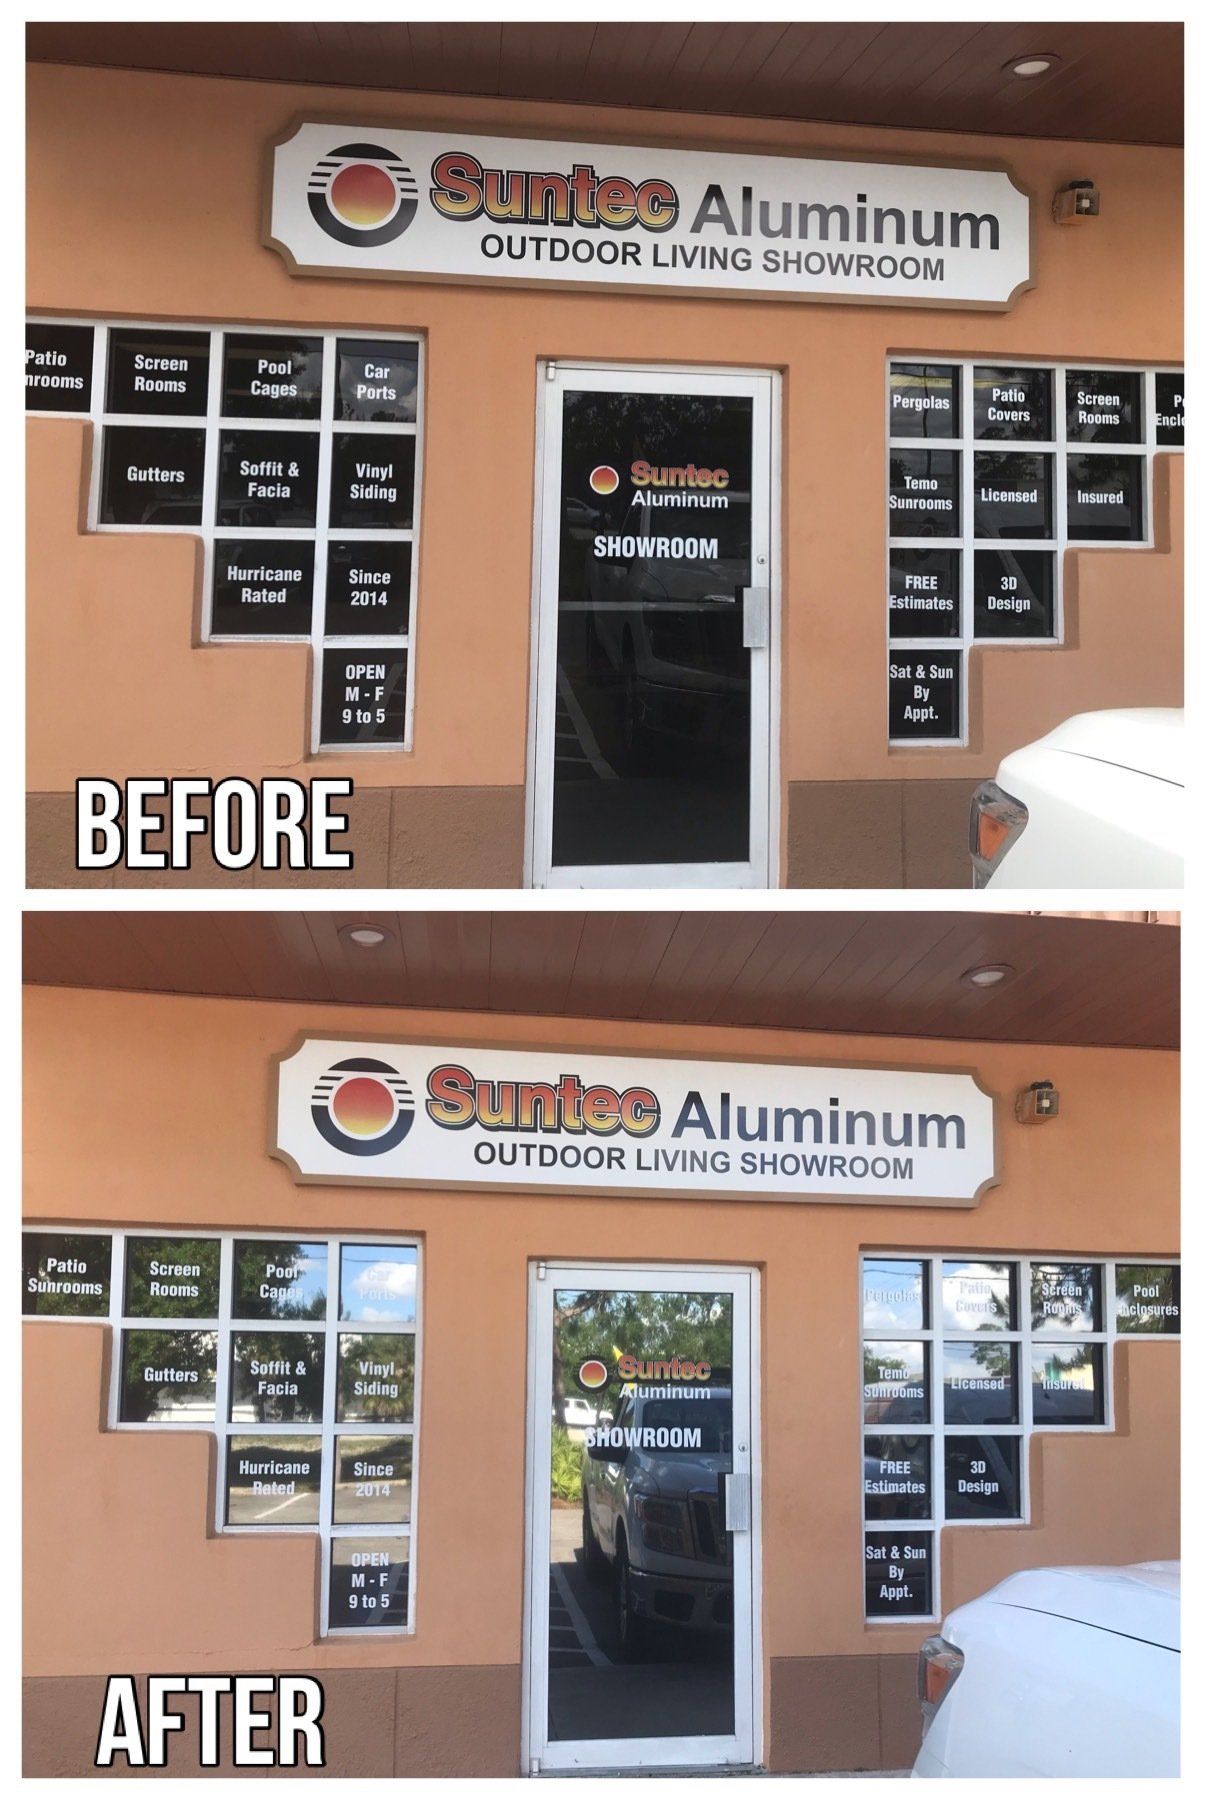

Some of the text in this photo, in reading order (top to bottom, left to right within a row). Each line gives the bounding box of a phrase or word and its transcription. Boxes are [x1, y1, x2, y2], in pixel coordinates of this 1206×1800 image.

[429, 151, 1000, 250] Suntec Aluminum
[480, 234, 944, 281] OUTDOOR LIVING SHOWROOM
[25, 349, 67, 366] Patio
[134, 354, 188, 372] Screen
[257, 359, 292, 375] Pool
[364, 364, 390, 379] Car
[134, 376, 187, 393] Rooms
[251, 381, 297, 398] Cages
[357, 384, 396, 400] Ports
[893, 394, 950, 411] Pergolas
[992, 388, 1025, 403] Patio
[1077, 392, 1120, 406] Screen
[988, 407, 1030, 422] Covers
[1079, 411, 1120, 425] Rooms
[127, 466, 185, 483] Gutters
[240, 460, 300, 478] Soffit &
[355, 463, 393, 481] Vinyl
[631, 460, 729, 488] Suntec
[248, 482, 291, 499] Facia
[904, 476, 938, 491] Temo
[350, 484, 397, 503] Siding
[632, 490, 728, 508] Aluminum
[981, 488, 1037, 503] Licensed
[1077, 490, 1124, 505] Insured
[889, 496, 953, 511] Sunrooms
[594, 535, 718, 559] SHOWROOM
[227, 566, 302, 582] Hurricane
[349, 569, 391, 585] Since
[905, 575, 938, 590] FREE
[1000, 576, 1017, 590] 3D
[241, 587, 287, 603] Rated
[350, 591, 387, 606] 2014
[889, 595, 954, 611] Estimates
[987, 596, 1030, 613] Design
[345, 664, 386, 680] OPEN
[889, 665, 953, 679] Sat & Sun
[345, 687, 359, 702] M
[375, 686, 385, 701] F
[913, 685, 930, 701] By
[342, 709, 386, 724] 9 to 5
[904, 705, 939, 722] Appt.
[425, 1064, 966, 1149] Suntec Aluminum
[474, 1142, 914, 1179] OUTDOOR LIVING SHOWROOM
[46, 1257, 87, 1274] Patio
[150, 1260, 200, 1278] Screen
[266, 1263, 298, 1279] Pool
[27, 1278, 103, 1295] Sunrooms
[150, 1281, 199, 1298] Rooms
[260, 1284, 303, 1302] Cages
[960, 1281, 991, 1294] Patio
[1042, 1283, 1082, 1296] Screen
[1133, 1284, 1159, 1297] Pool
[955, 1300, 997, 1313] Covers
[1043, 1301, 1082, 1314] Rooms
[1116, 1303, 1179, 1316] nclosures
[144, 1367, 199, 1383] Gutters
[250, 1360, 307, 1376] Soffit &
[359, 1361, 394, 1378] Vinyl
[618, 1355, 712, 1381] Suntec
[878, 1366, 910, 1380] Temo
[258, 1381, 299, 1396] Facia
[354, 1381, 399, 1399] Siding
[951, 1377, 1005, 1390] Licensed
[619, 1384, 711, 1400] Aluminum
[864, 1385, 924, 1399] Sunrooms
[585, 1427, 701, 1448] SHOWROOM
[239, 1460, 310, 1475] Hurricane
[354, 1462, 393, 1476] Since
[880, 1461, 911, 1475] FREE
[970, 1460, 986, 1474] 3D
[253, 1481, 295, 1495] Rated
[355, 1483, 390, 1497] 2014
[864, 1479, 926, 1494] Estimates
[958, 1480, 999, 1495] Design
[351, 1552, 389, 1567] OPEN
[865, 1545, 927, 1559] Sat & Sun
[351, 1573, 365, 1588] M
[379, 1573, 389, 1587] F
[888, 1565, 905, 1581] By
[879, 1584, 913, 1600] Appt.
[349, 1594, 390, 1609] 9 to 5
